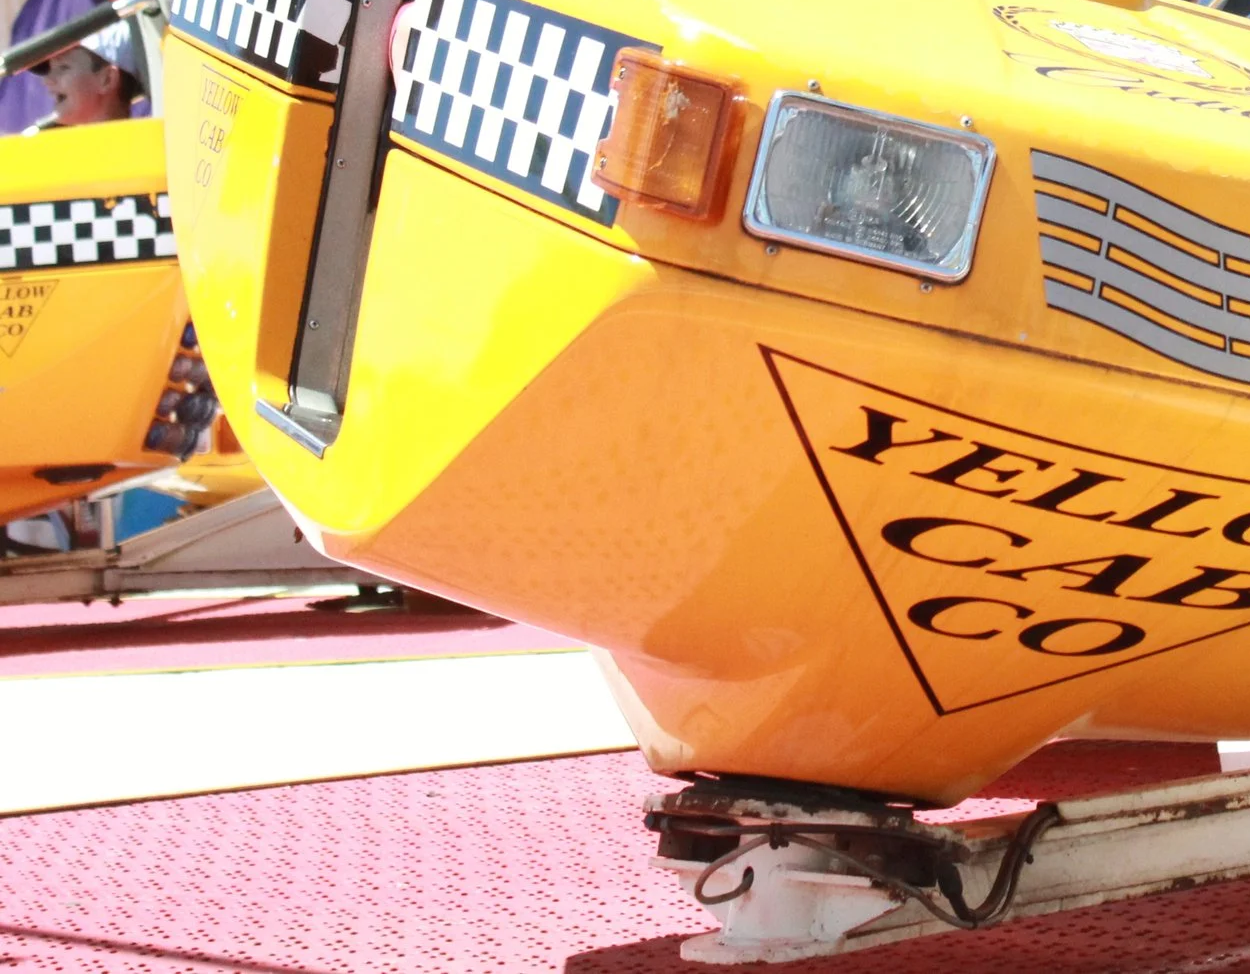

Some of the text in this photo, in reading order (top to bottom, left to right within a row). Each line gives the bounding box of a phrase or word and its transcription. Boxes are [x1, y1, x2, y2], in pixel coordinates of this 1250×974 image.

[201, 77, 244, 116] YELLOW
[199, 119, 225, 154] CAB
[194, 158, 212, 188] CO
[0, 285, 51, 300] LOW
[908, 597, 1147, 657] CO
